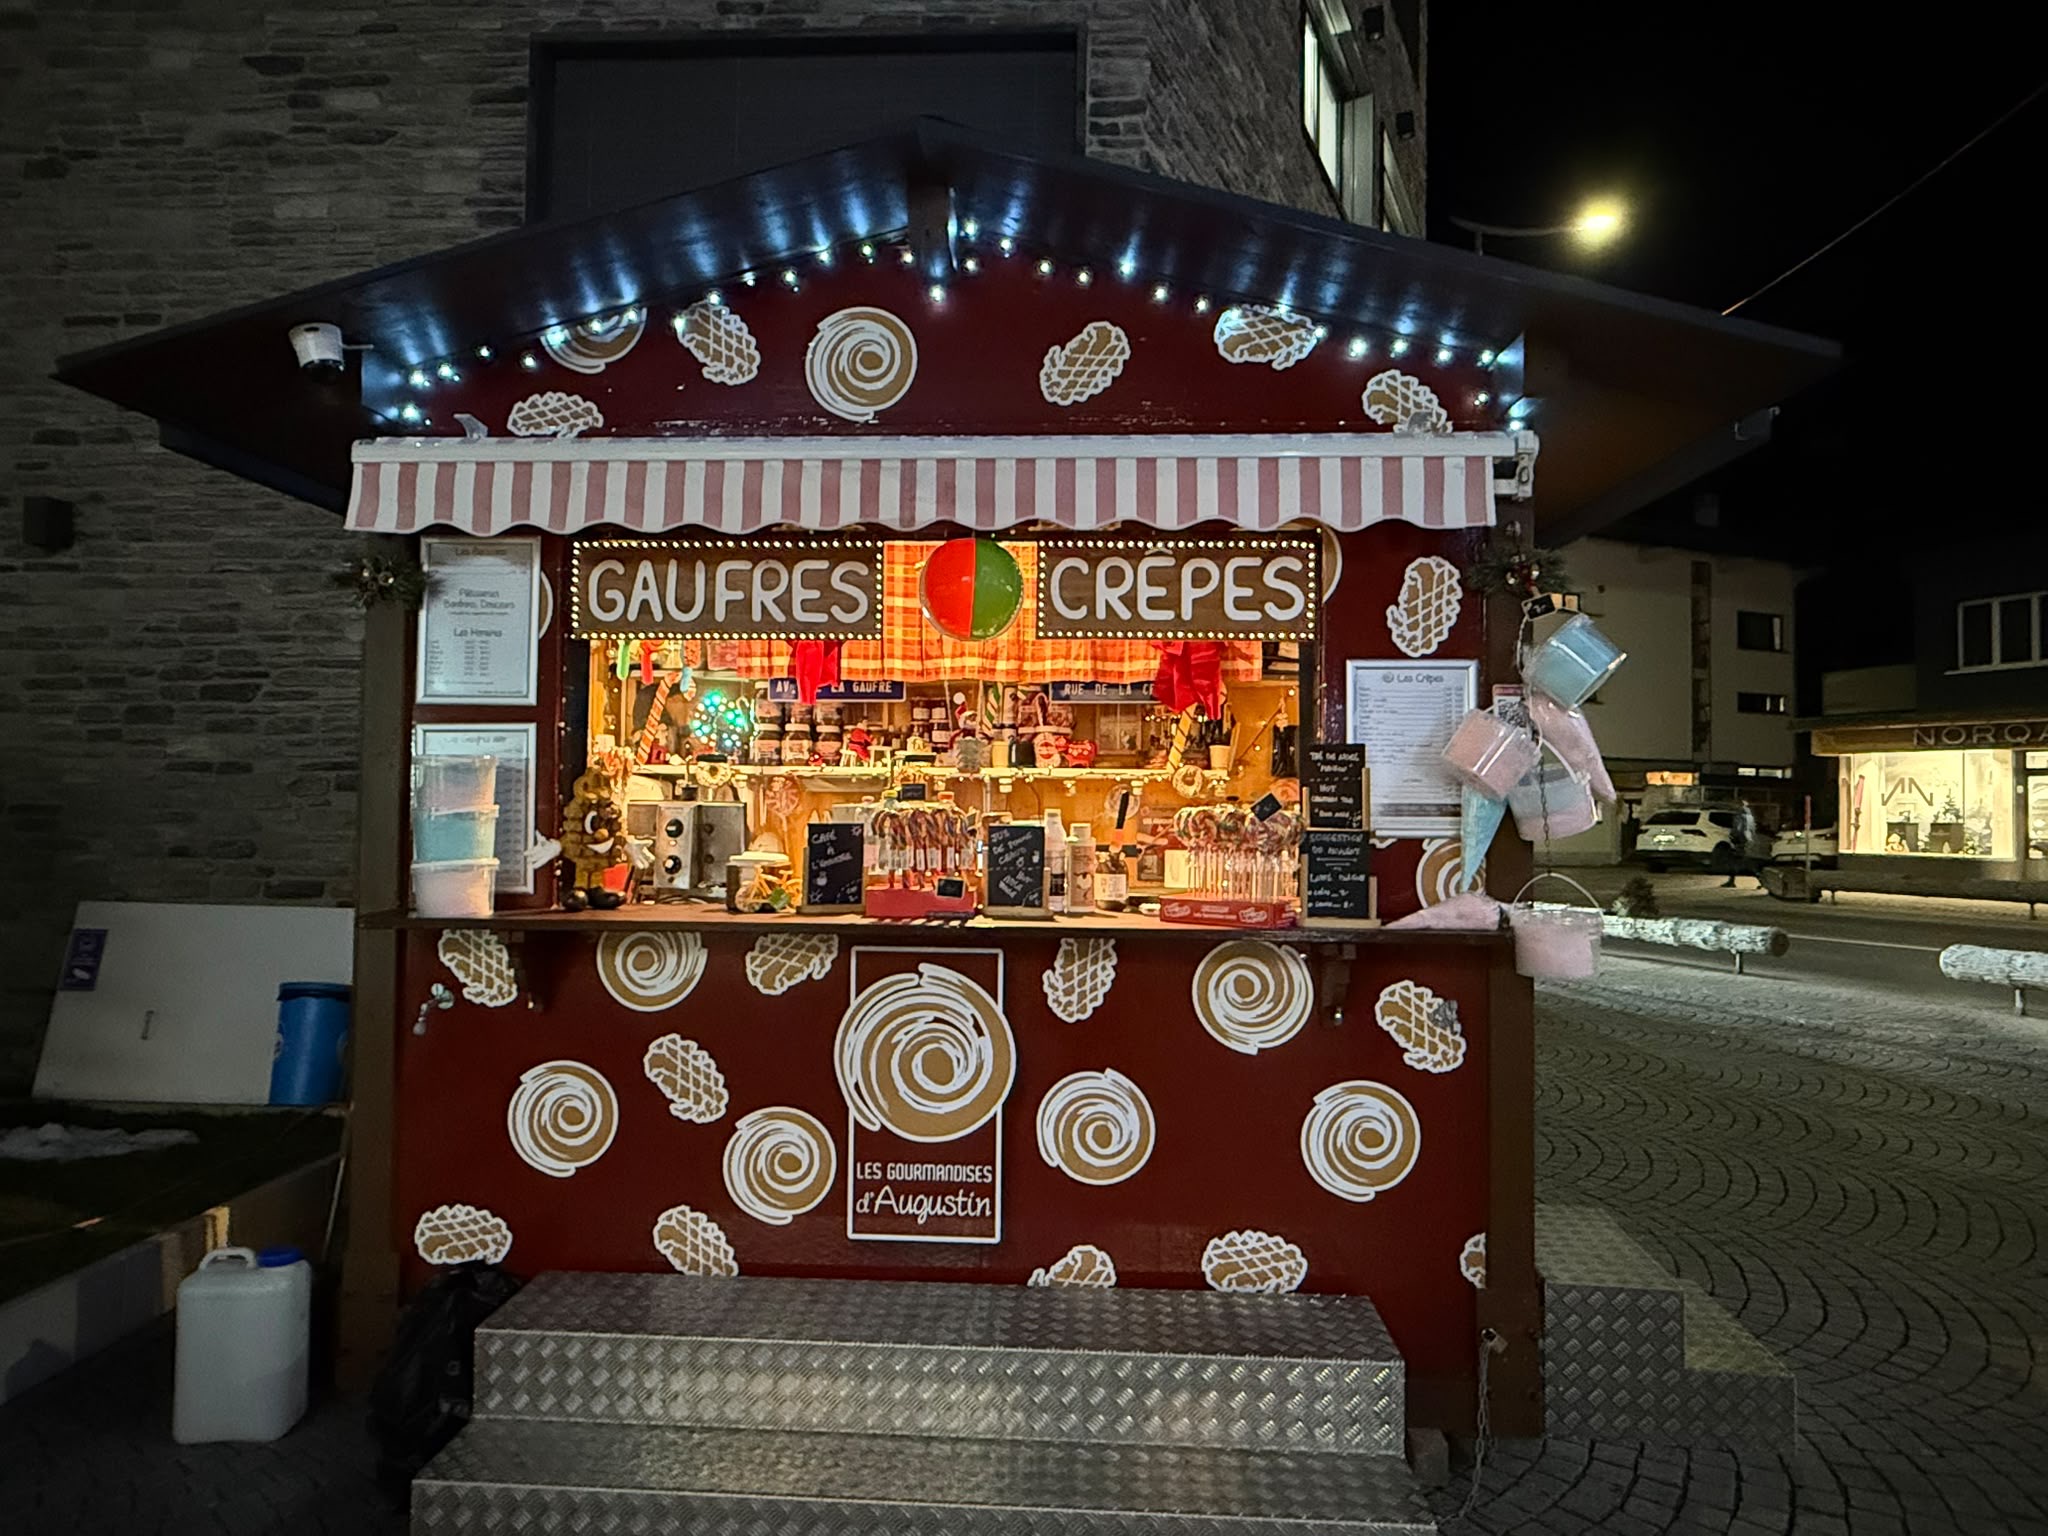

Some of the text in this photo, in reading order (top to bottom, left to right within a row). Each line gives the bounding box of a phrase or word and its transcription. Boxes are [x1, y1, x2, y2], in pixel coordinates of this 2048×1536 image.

[588, 558, 869, 624] GAUFRES
[1050, 547, 1305, 621] CRÊPES
[852, 681, 893, 693] GAUFRE
[1063, 683, 1085, 696] RUE
[1095, 683, 1108, 696] DE
[1118, 683, 1132, 696] LA
[856, 1162, 993, 1183] LES GOURMANDISES
[855, 1184, 992, 1225] d'Augustin
